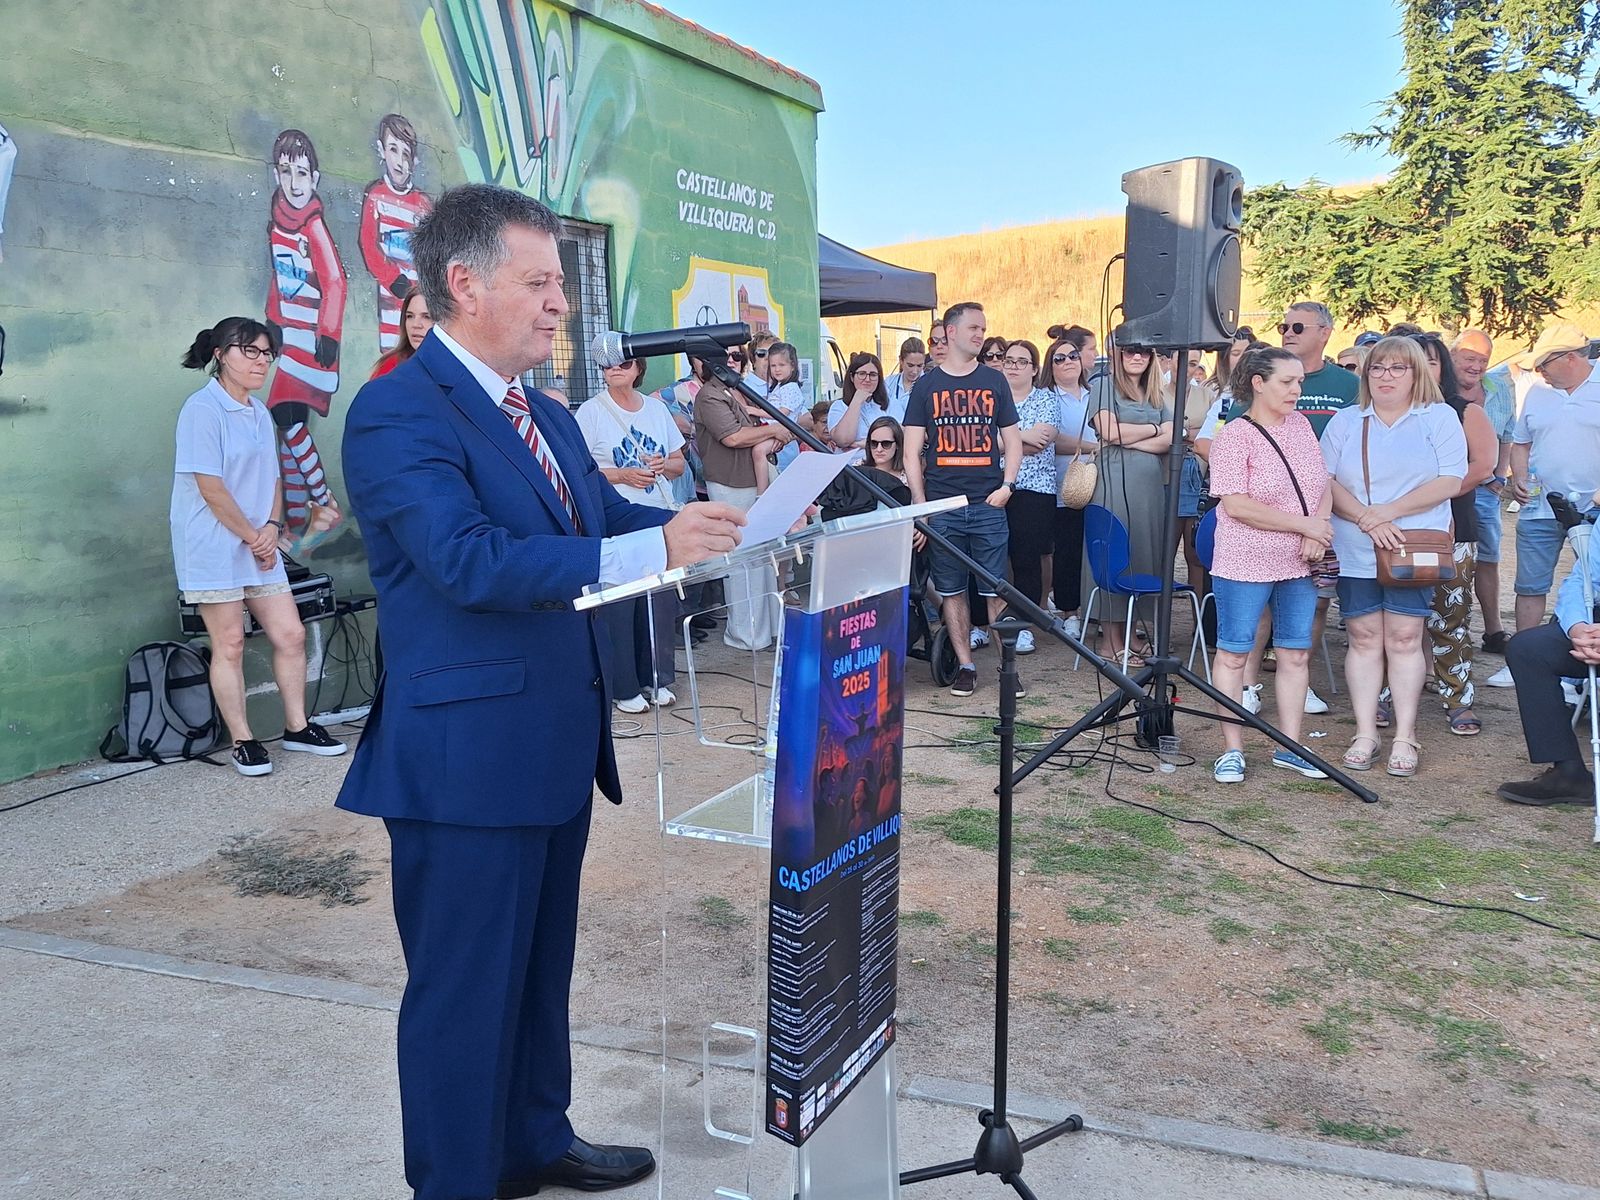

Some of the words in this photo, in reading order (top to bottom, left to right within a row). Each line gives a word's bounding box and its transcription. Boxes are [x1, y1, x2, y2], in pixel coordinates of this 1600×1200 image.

[677, 168, 757, 208] CASTELLANOS
[759, 190, 775, 212] DE
[679, 200, 754, 235] VILLIQUERA
[757, 219, 777, 241] C.D.
[1298, 394, 1344, 404] mpion
[936, 425, 992, 452] JONES
[840, 609, 877, 638] FIESTAS
[850, 635, 861, 650] DE
[832, 653, 853, 679] SAN
[854, 644, 881, 670] JUAN
[842, 670, 871, 697] 2025
[778, 839, 856, 892] CASTELLANOS
[858, 830, 873, 855] DE
